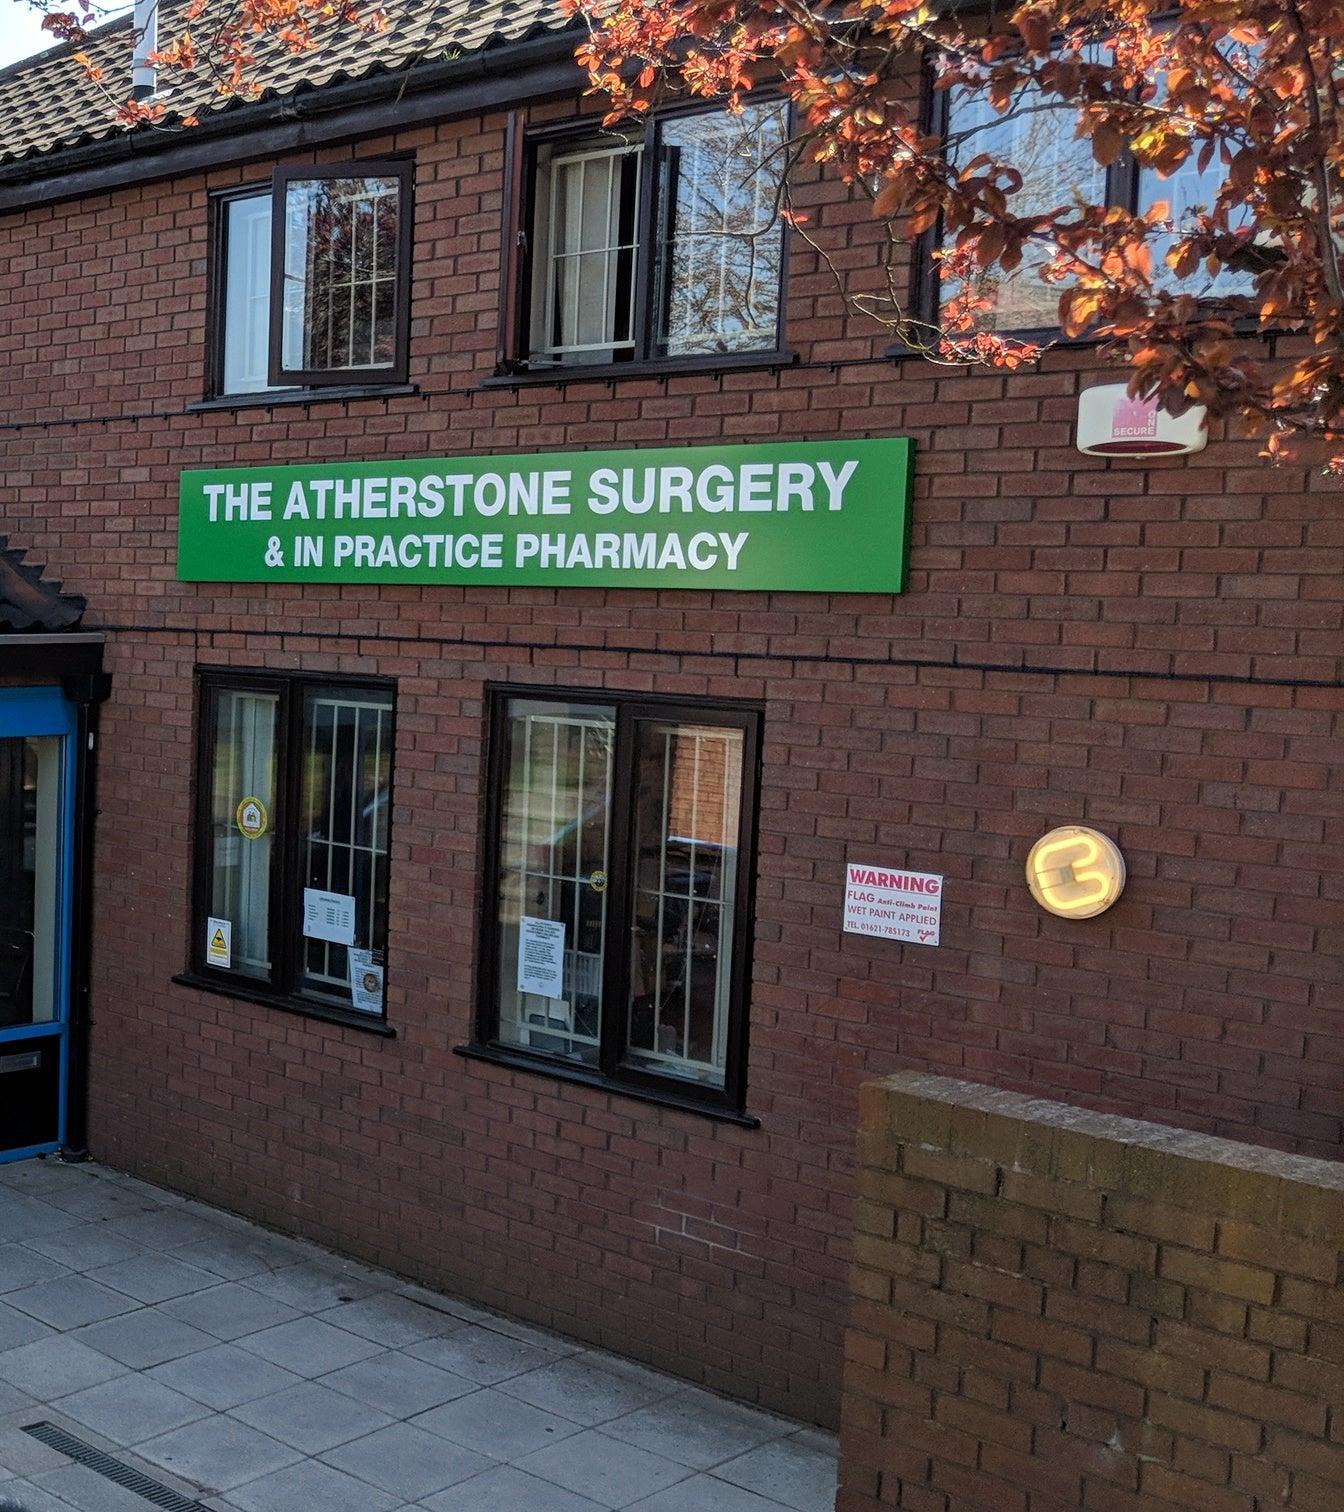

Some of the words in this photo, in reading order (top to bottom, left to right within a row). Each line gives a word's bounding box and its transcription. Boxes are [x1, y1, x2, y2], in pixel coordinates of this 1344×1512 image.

[1114, 427, 1154, 436] SECURE
[203, 482, 272, 522] THE
[283, 470, 572, 520] ATHERSTONE
[587, 460, 859, 515] SURGERY
[264, 536, 285, 567] &
[294, 536, 323, 567] IN
[334, 534, 503, 568] PRACTICE
[515, 532, 749, 571] PHARMACY
[850, 869, 939, 893] WARNING
[847, 890, 875, 903] FLAG
[877, 898, 916, 909] Anti-Climb
[847, 905, 867, 915] WET
[869, 908, 896, 920] PAINT
[898, 913, 937, 926] APPLIED
[861, 923, 910, 937] 01621-785173
